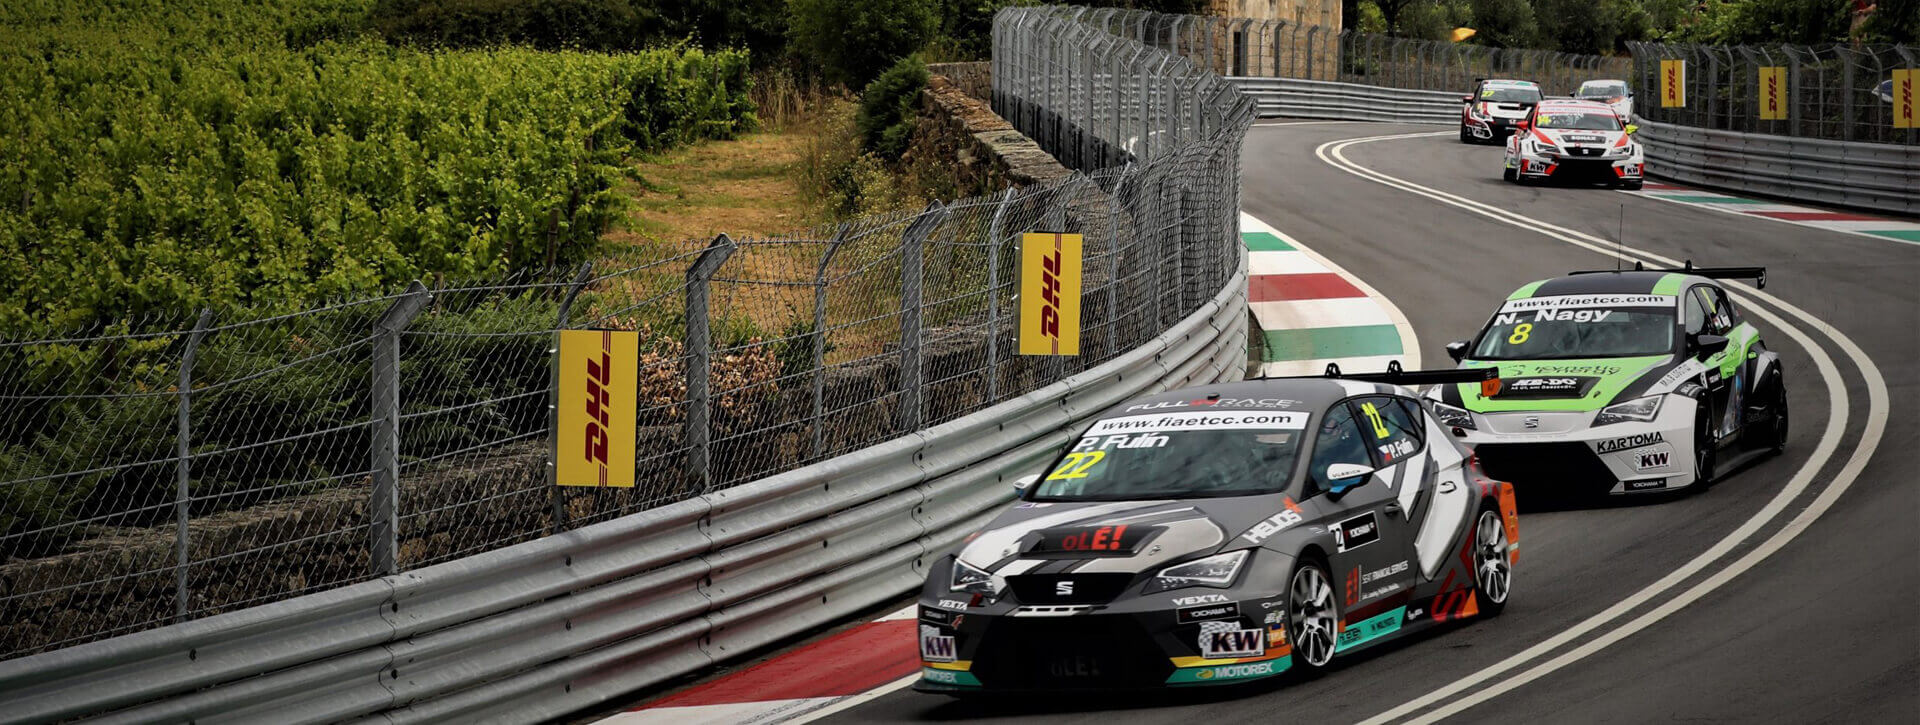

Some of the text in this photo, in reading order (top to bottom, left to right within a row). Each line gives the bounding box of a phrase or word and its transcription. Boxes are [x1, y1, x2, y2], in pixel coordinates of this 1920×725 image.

[1769, 74, 1777, 112] DHL
[1903, 78, 1912, 119] DHL
[1530, 162, 1545, 172] KW
[1041, 249, 1061, 338] DHL
[1513, 295, 1665, 308] www.fiaetcc.com
[1494, 308, 1612, 326] N. Nagy
[1508, 323, 1533, 345] 8
[585, 352, 610, 466] DHL
[1125, 401, 1190, 412] FULL
[1214, 398, 1296, 407] RACE
[1102, 415, 1292, 430] www.fiaetcc.com
[1072, 432, 1170, 452] P. Fulín
[1597, 431, 1664, 452] KARTOMA
[1046, 450, 1107, 481] 22
[1641, 452, 1669, 467] KW
[1242, 508, 1303, 544] HELIOS
[938, 599, 969, 611] VEXTA
[1172, 594, 1229, 606] VEXTA
[925, 636, 953, 657] KW
[1210, 630, 1262, 653] KW
[1215, 662, 1274, 678] MOTOREX
